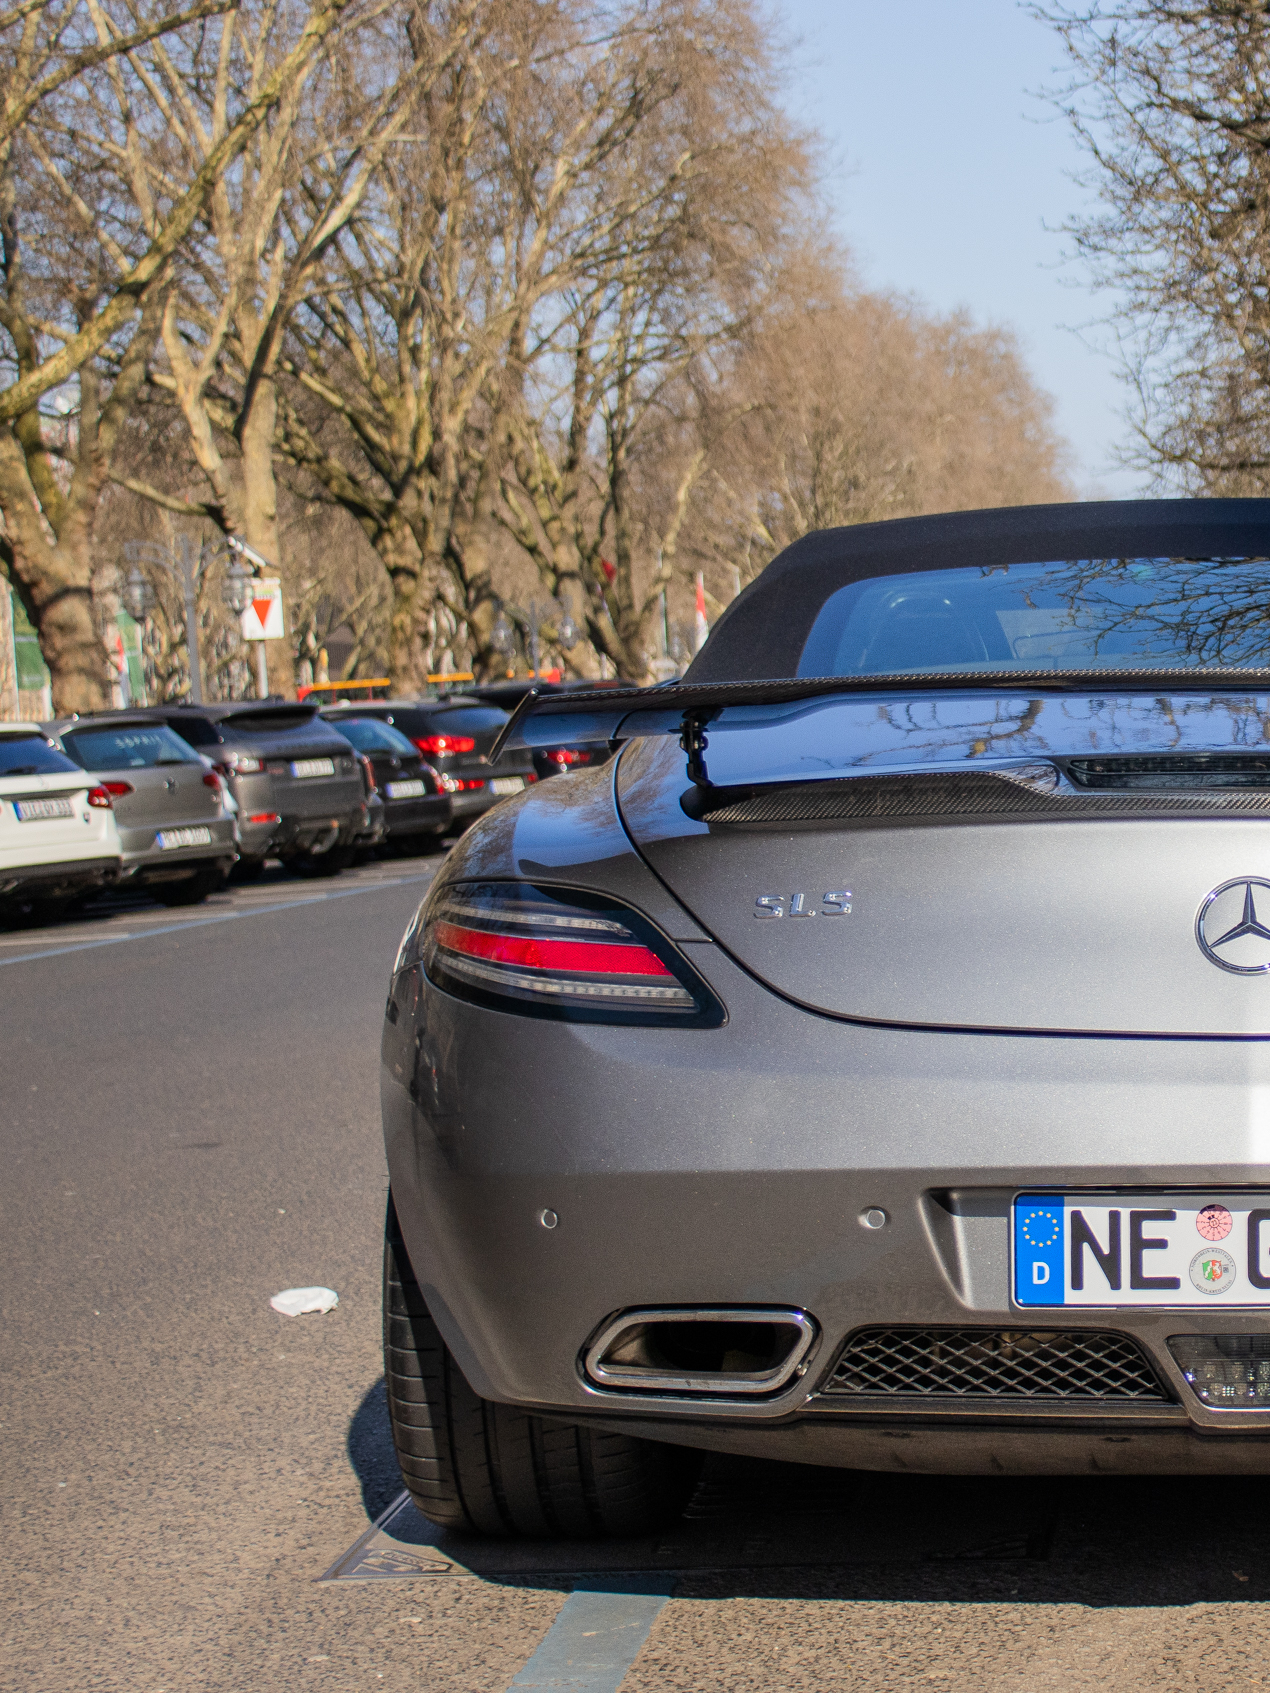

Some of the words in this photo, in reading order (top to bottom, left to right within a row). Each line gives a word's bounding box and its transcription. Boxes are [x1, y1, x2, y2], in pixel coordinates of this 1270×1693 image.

[753, 890, 852, 919] SLS
[1070, 1209, 1181, 1290] NE
[1032, 1261, 1050, 1285] D
